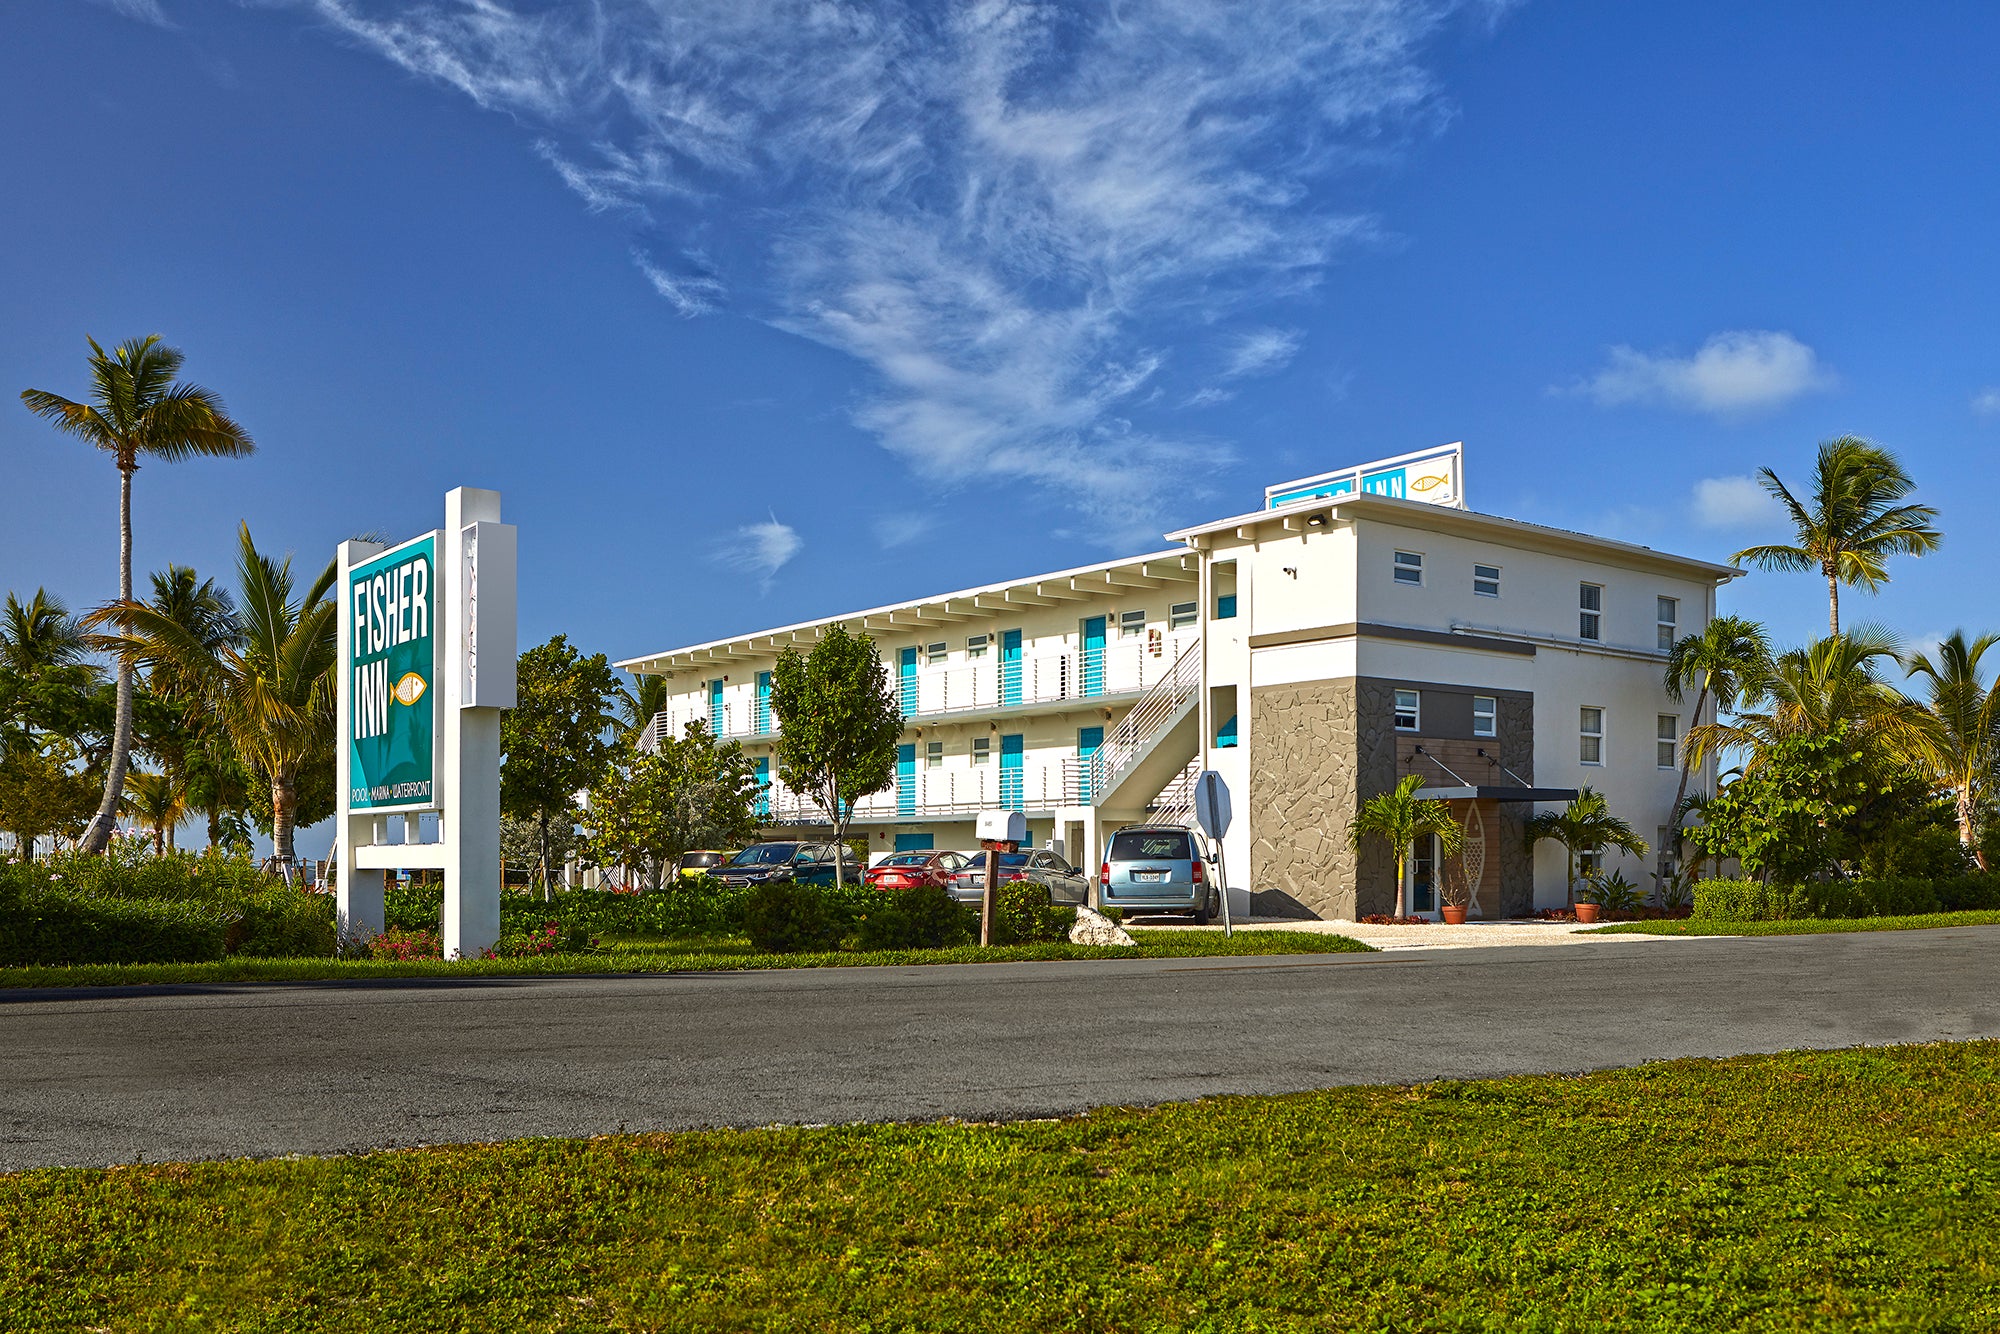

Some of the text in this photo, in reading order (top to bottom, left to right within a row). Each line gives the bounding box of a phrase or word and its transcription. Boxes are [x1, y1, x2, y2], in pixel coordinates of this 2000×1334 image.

[353, 558, 428, 658] FISHER
[355, 658, 388, 739] INN
[351, 781, 431, 803] POOL MARINA WATERFRONT
